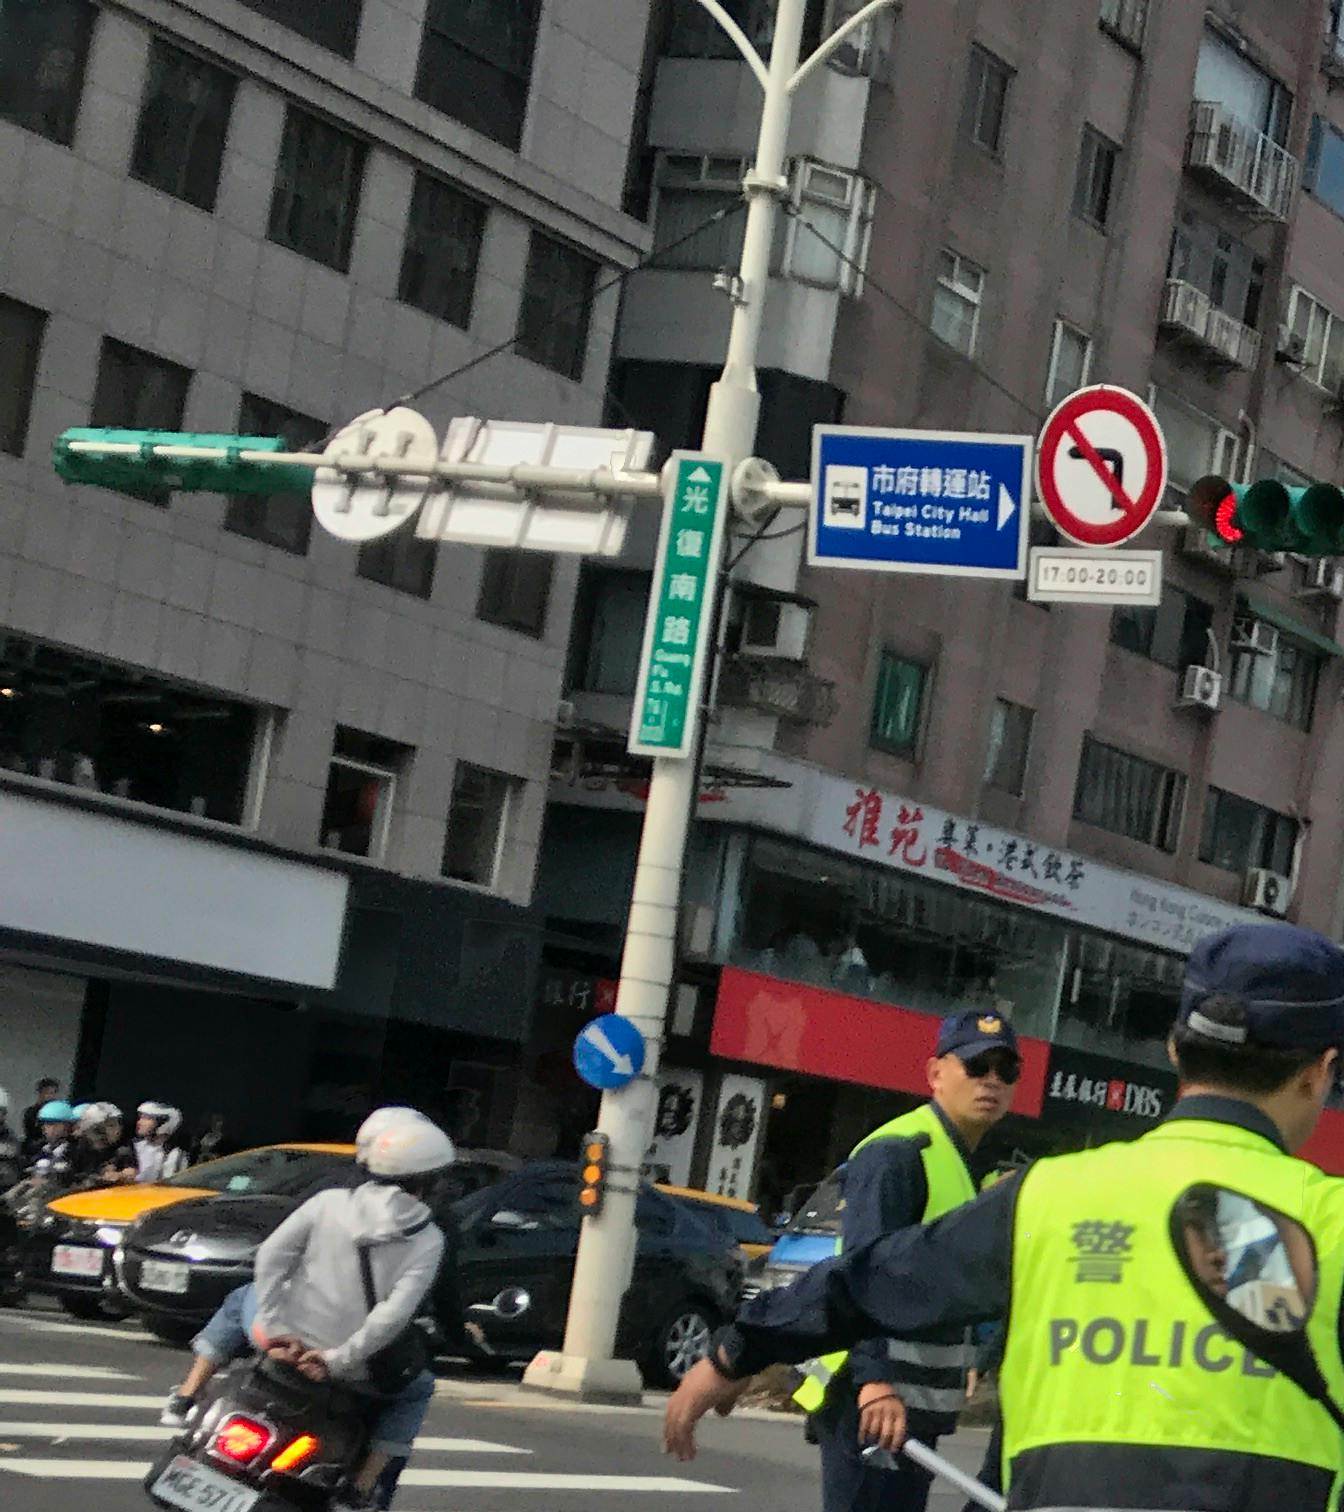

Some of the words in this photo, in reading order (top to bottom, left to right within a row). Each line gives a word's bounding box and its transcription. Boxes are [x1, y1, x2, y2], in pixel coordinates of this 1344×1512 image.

[871, 463, 991, 500] 市府轉運站
[870, 519, 900, 537] Bus
[905, 521, 962, 540] Station
[872, 501, 918, 520] Taipei
[921, 503, 954, 525] City
[958, 505, 990, 523] Hall
[661, 485, 709, 645] 光復南路
[1123, 1082, 1163, 1118] DBS
[1066, 1218, 1137, 1284] 警
